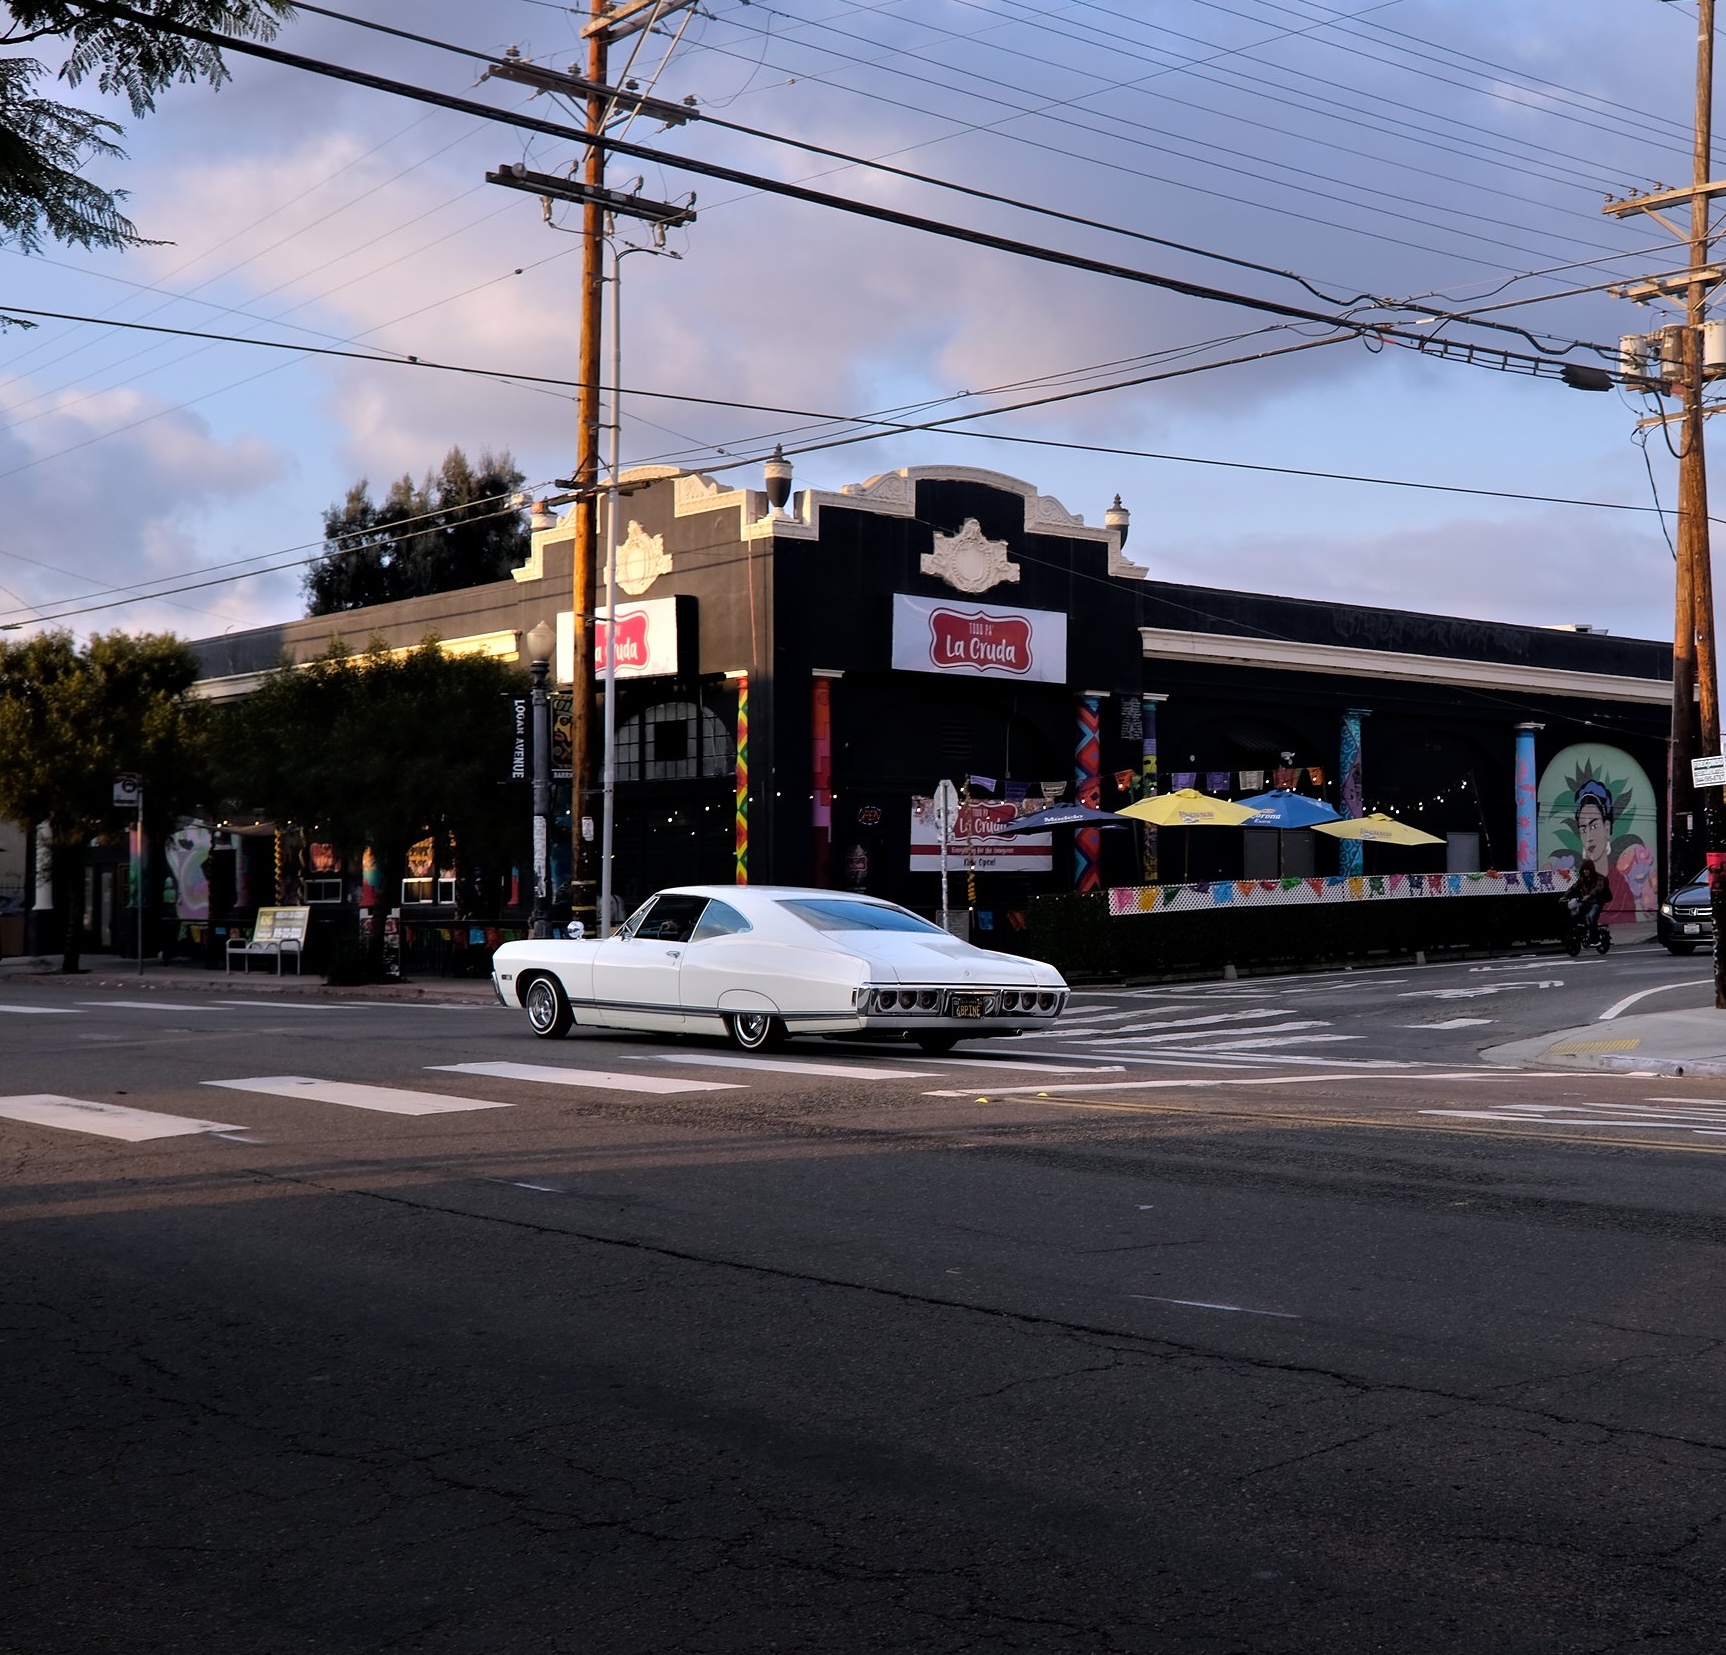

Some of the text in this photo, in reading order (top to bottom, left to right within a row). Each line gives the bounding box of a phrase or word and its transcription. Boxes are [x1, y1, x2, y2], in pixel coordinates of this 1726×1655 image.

[969, 622, 983, 636] TODO
[946, 634, 1016, 663] La Cruda
[512, 699, 526, 778] LOGAN AVENUE
[859, 809, 880, 821] OPEN
[1044, 814, 1084, 823] Modelo
